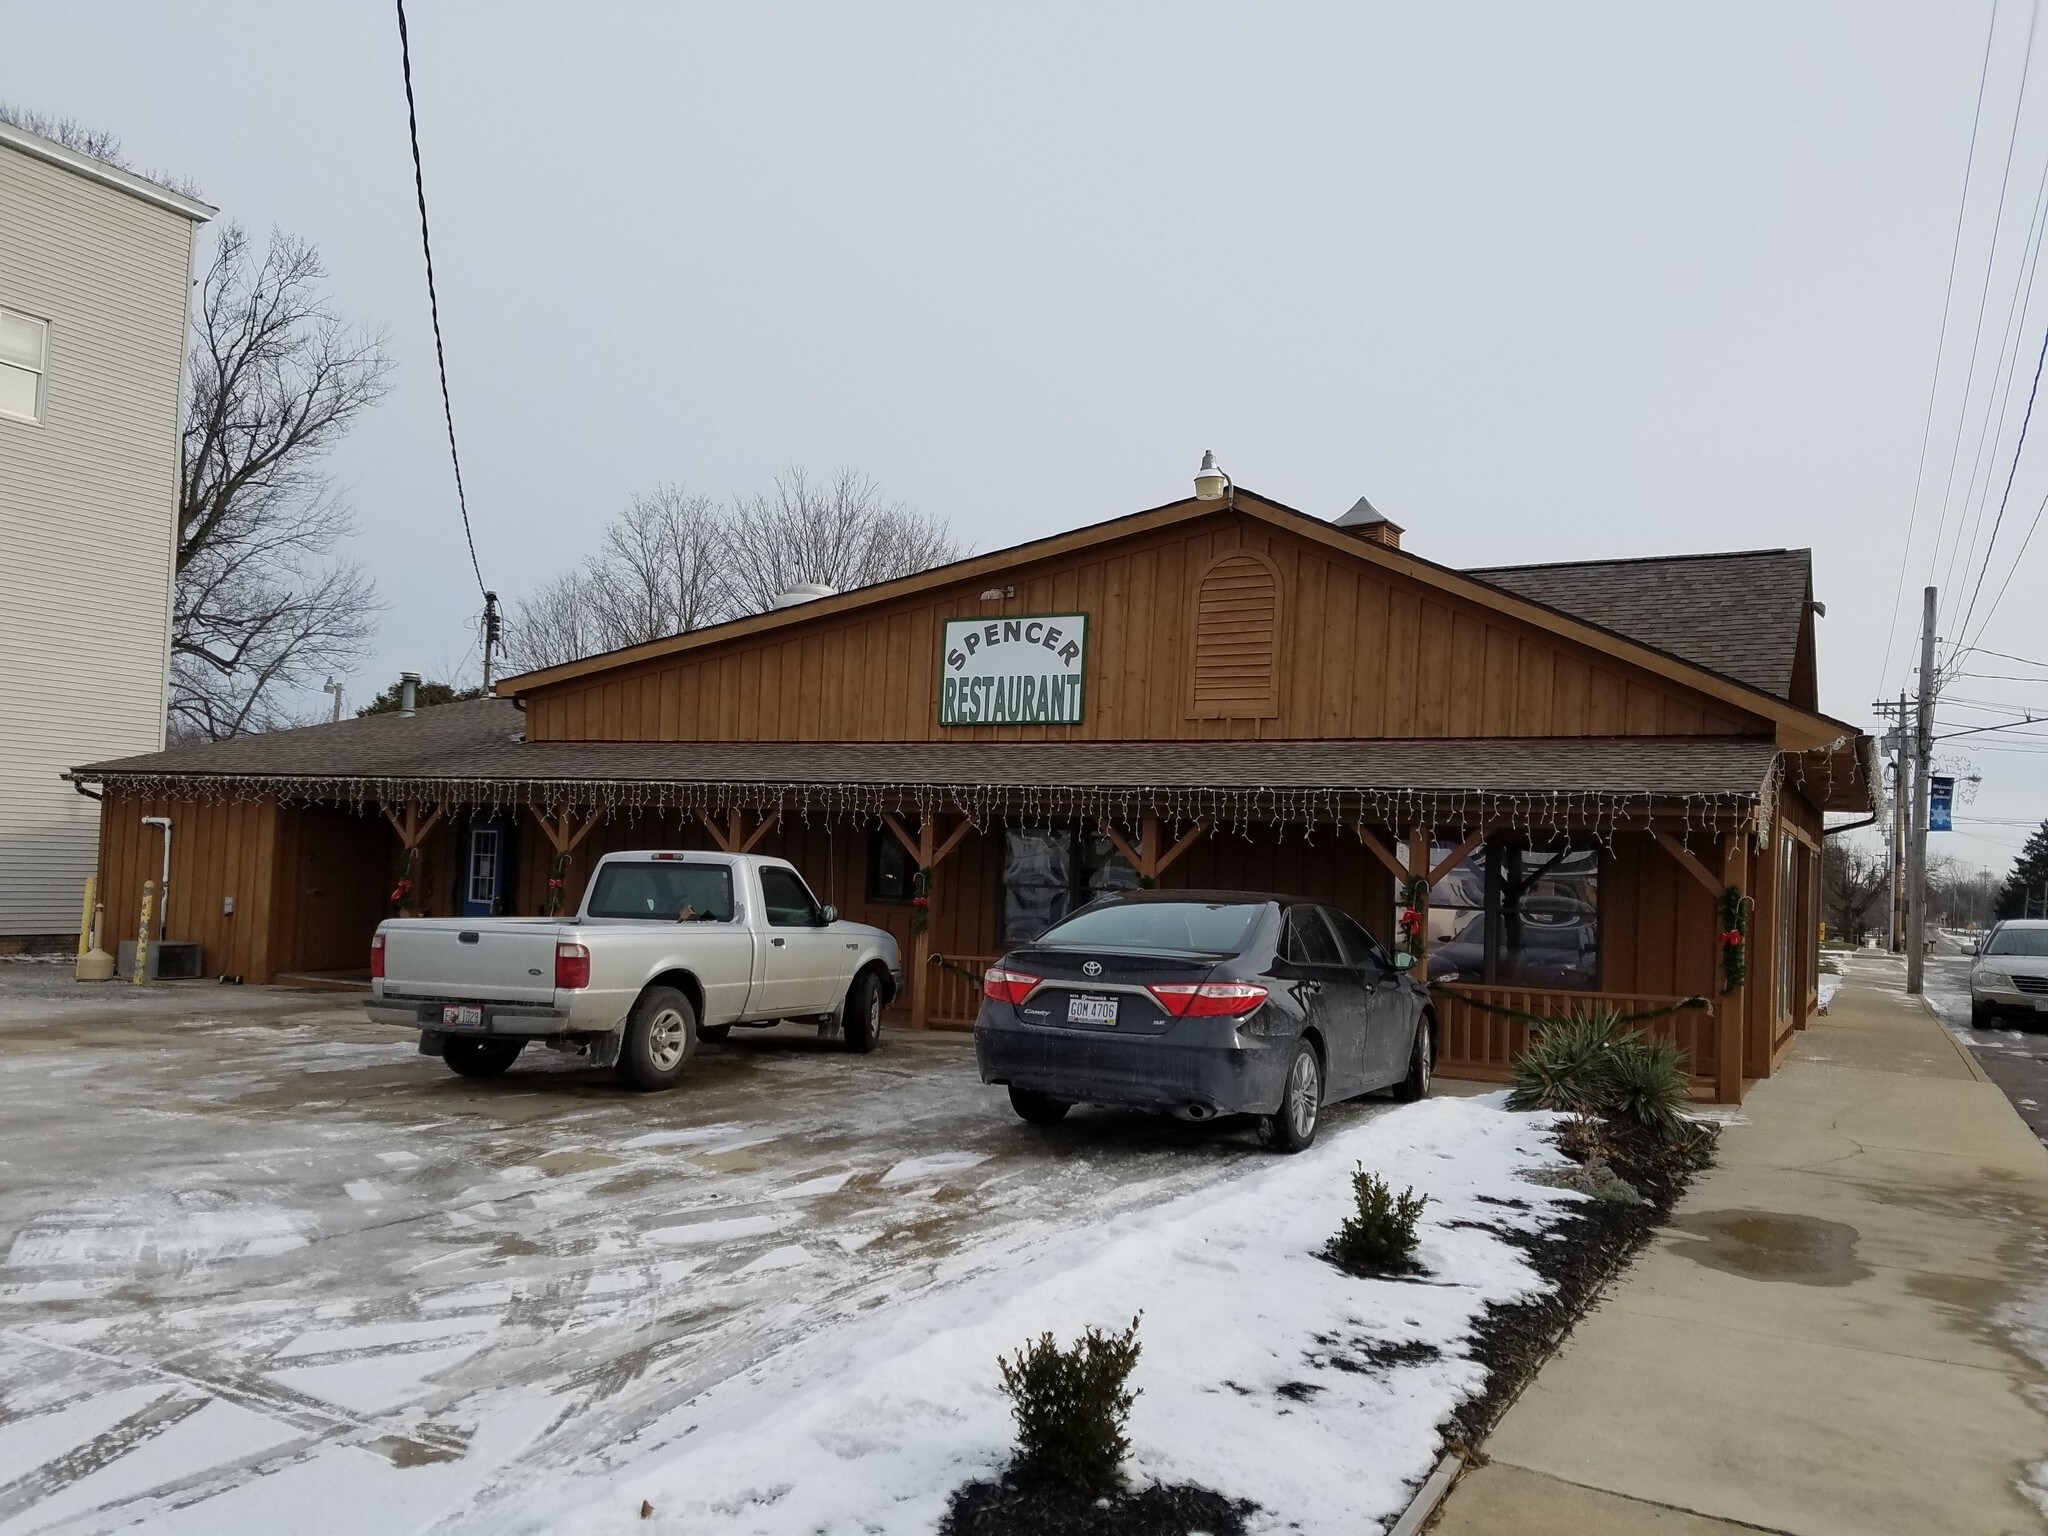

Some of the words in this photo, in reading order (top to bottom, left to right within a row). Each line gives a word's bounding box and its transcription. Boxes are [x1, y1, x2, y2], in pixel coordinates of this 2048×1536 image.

[947, 620, 1080, 672] SPENCER
[944, 674, 1080, 723] RESTAURANT
[1070, 1001, 1089, 1017] GOM
[1091, 1003, 1115, 1018] 4706
